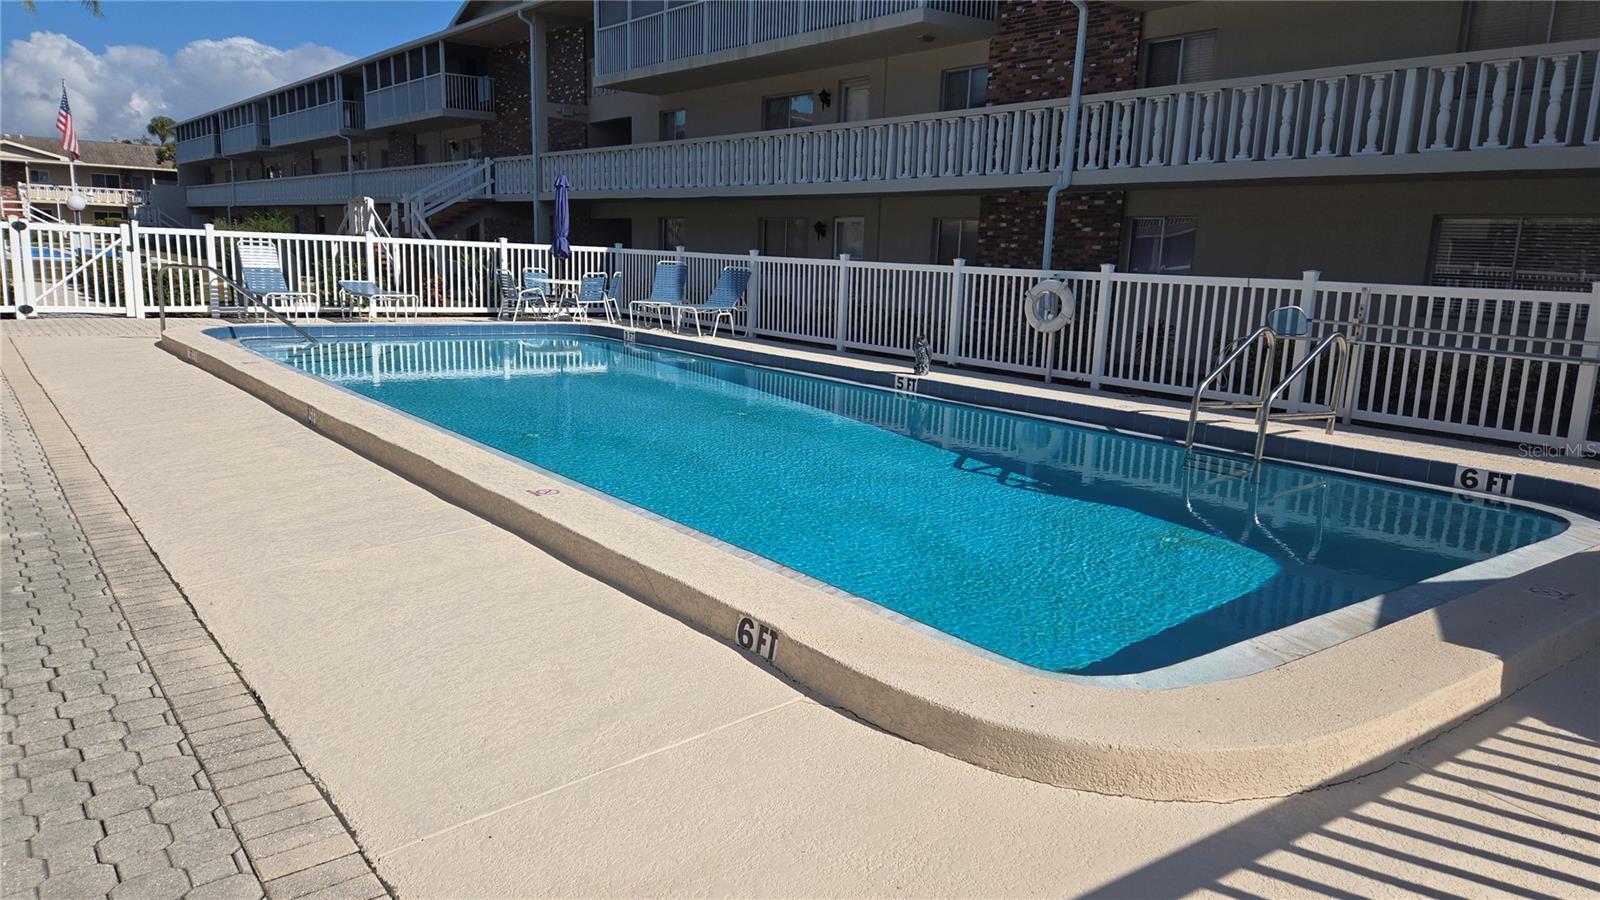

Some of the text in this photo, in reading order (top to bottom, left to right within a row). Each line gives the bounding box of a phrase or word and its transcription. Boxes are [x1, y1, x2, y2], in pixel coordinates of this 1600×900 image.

[897, 376, 917, 392] 5 FT
[1460, 468, 1512, 495] 6 FT
[738, 617, 778, 660] 6 FT
